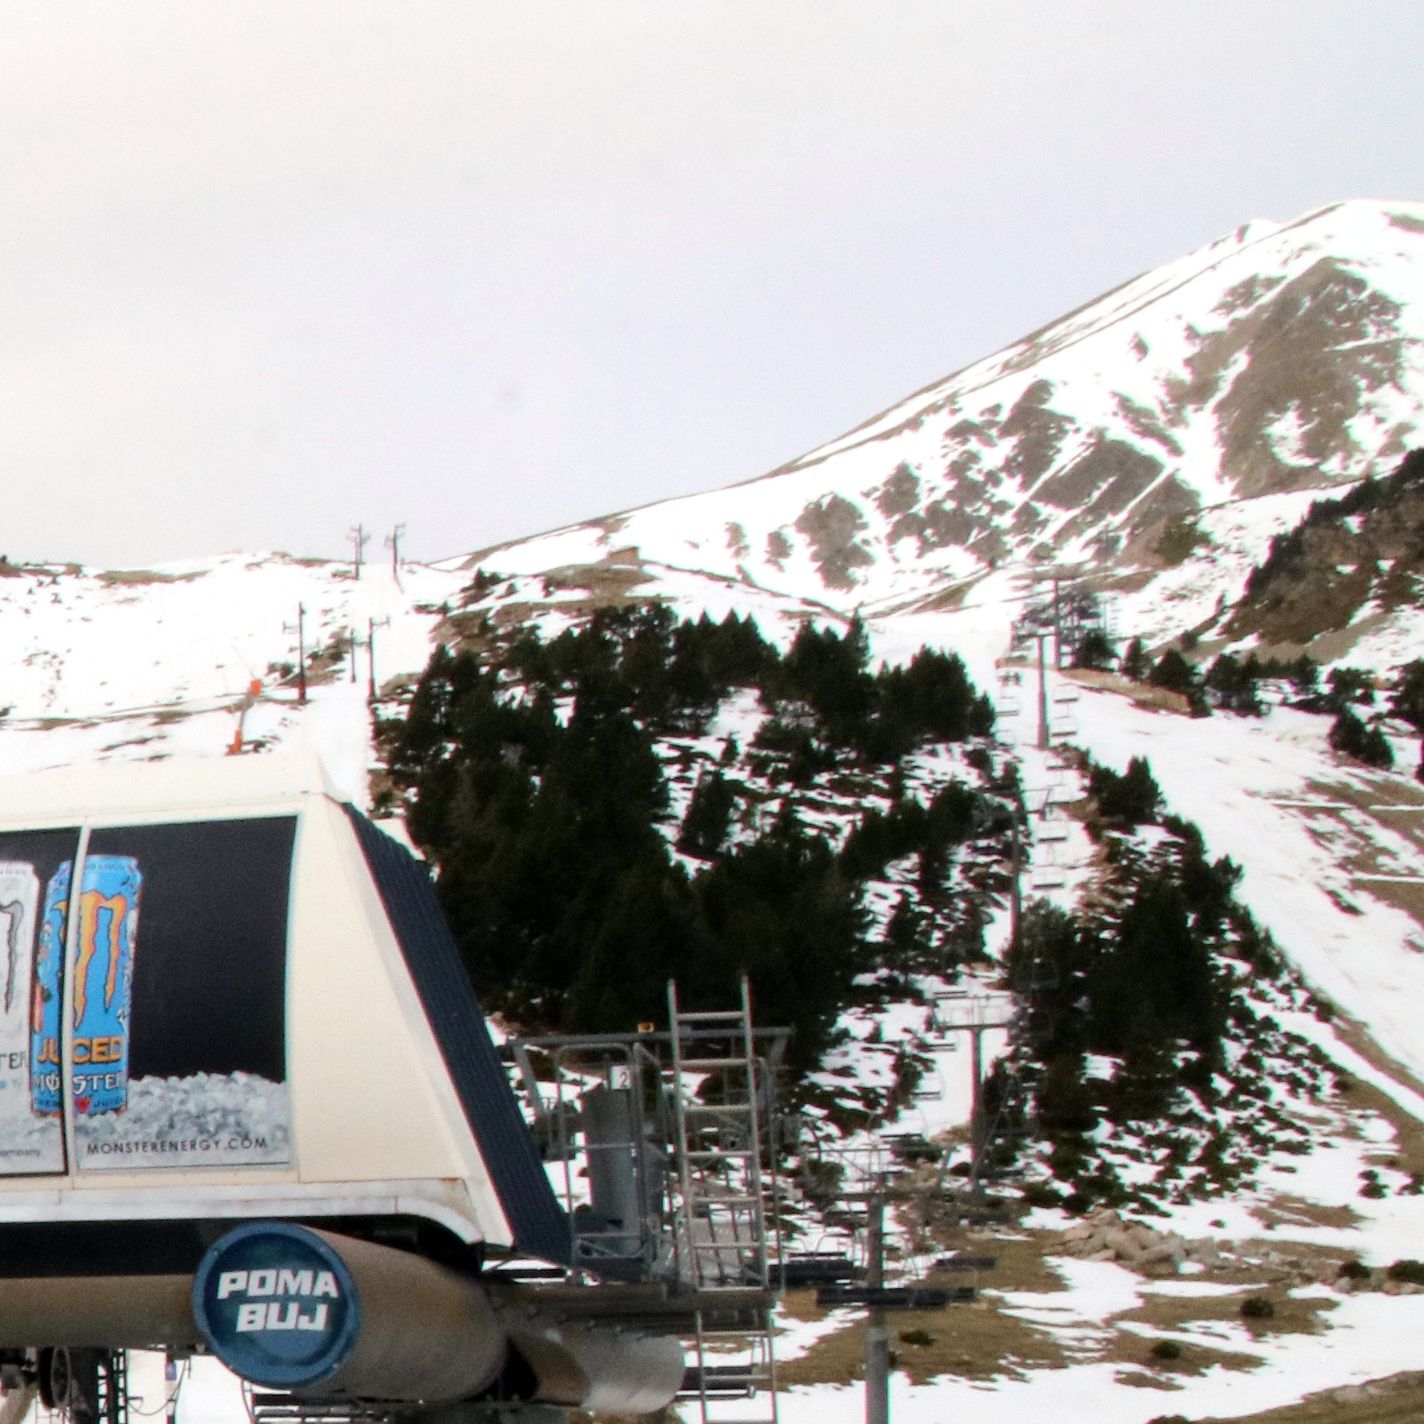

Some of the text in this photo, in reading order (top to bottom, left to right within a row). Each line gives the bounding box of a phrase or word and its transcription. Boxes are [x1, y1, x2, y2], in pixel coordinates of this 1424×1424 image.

[86, 1137, 268, 1155] MONSTERENERGY.COM
[217, 1269, 339, 1299] POMA
[236, 1302, 329, 1332] BUJ
